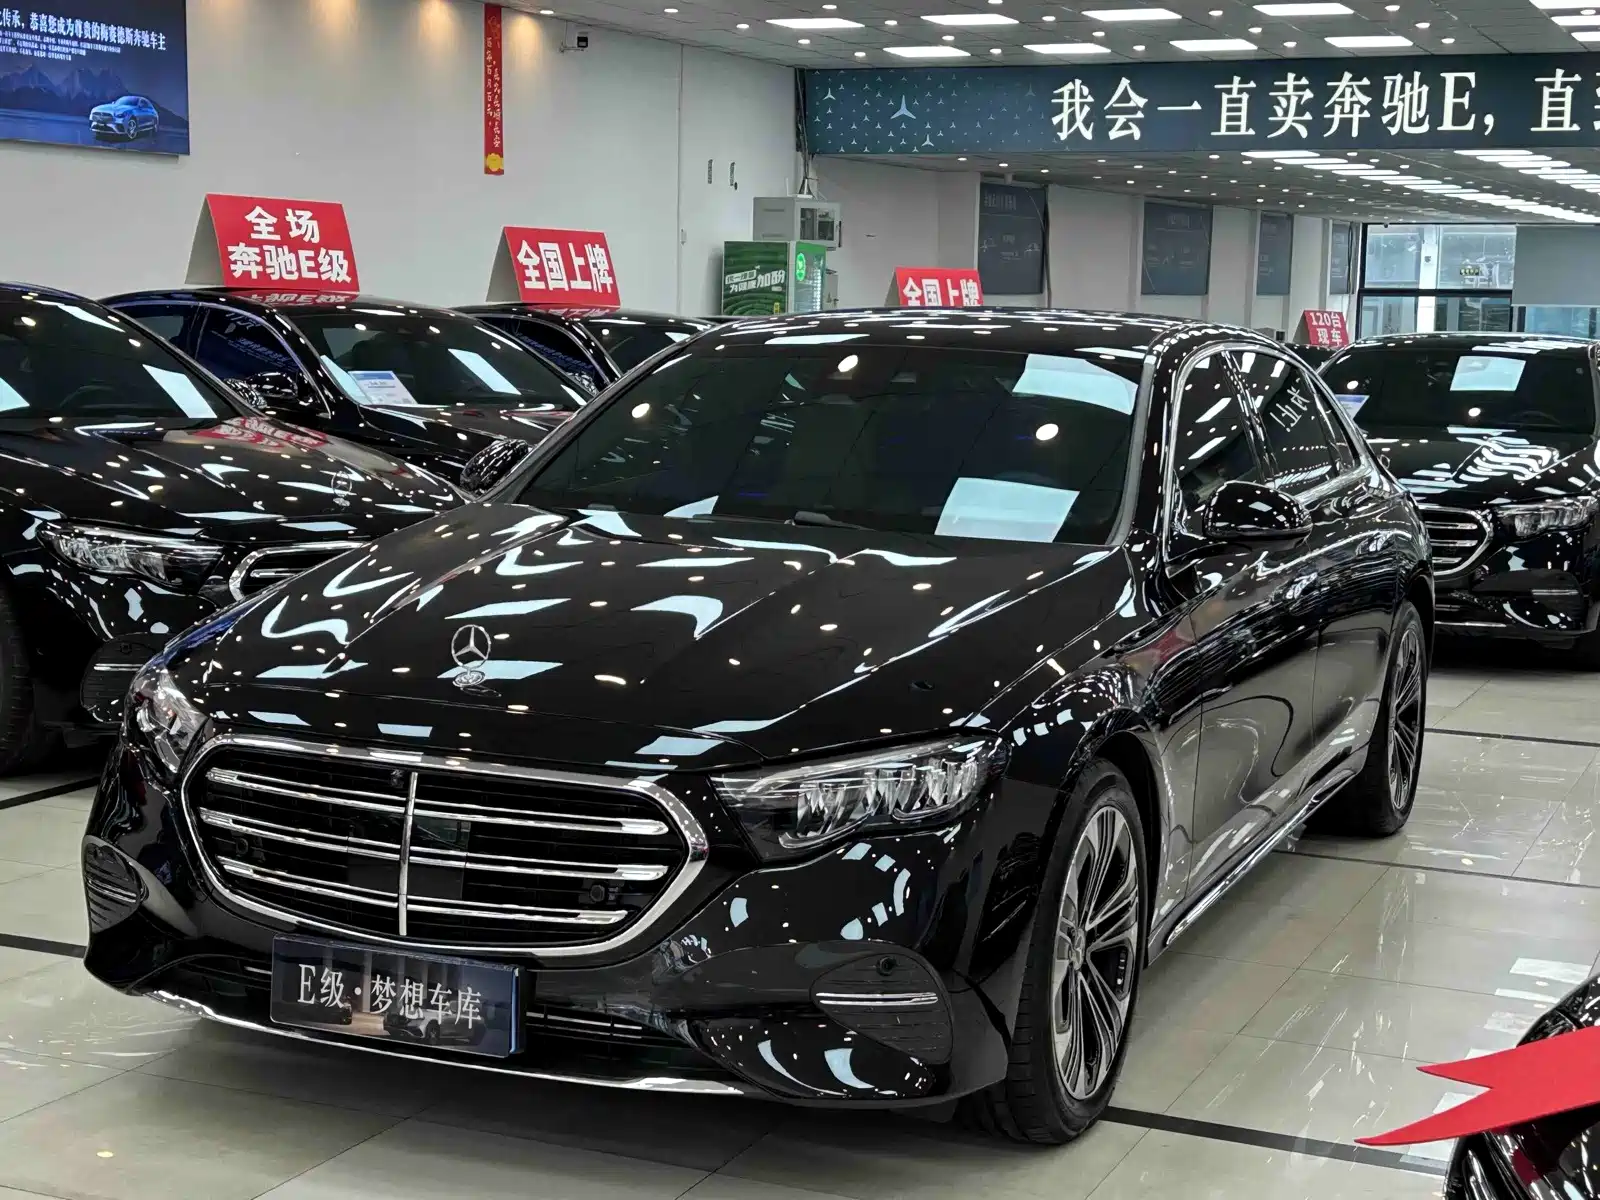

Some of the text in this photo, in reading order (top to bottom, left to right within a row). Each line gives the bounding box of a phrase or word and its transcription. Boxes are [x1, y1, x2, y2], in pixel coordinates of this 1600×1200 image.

[0, 8, 166, 51] 传承，恭喜您成为尊贵的梅赛德斯奔驰车主
[1051, 68, 1600, 141] 我会一直卖奔驰E，直
[244, 206, 320, 243] 全场
[227, 242, 352, 284] 奔驰E级
[516, 239, 614, 293] 全国上牌
[1310, 312, 1342, 329] 120台
[1316, 328, 1343, 346] 现车
[297, 963, 483, 1030] E级·梦想车库
